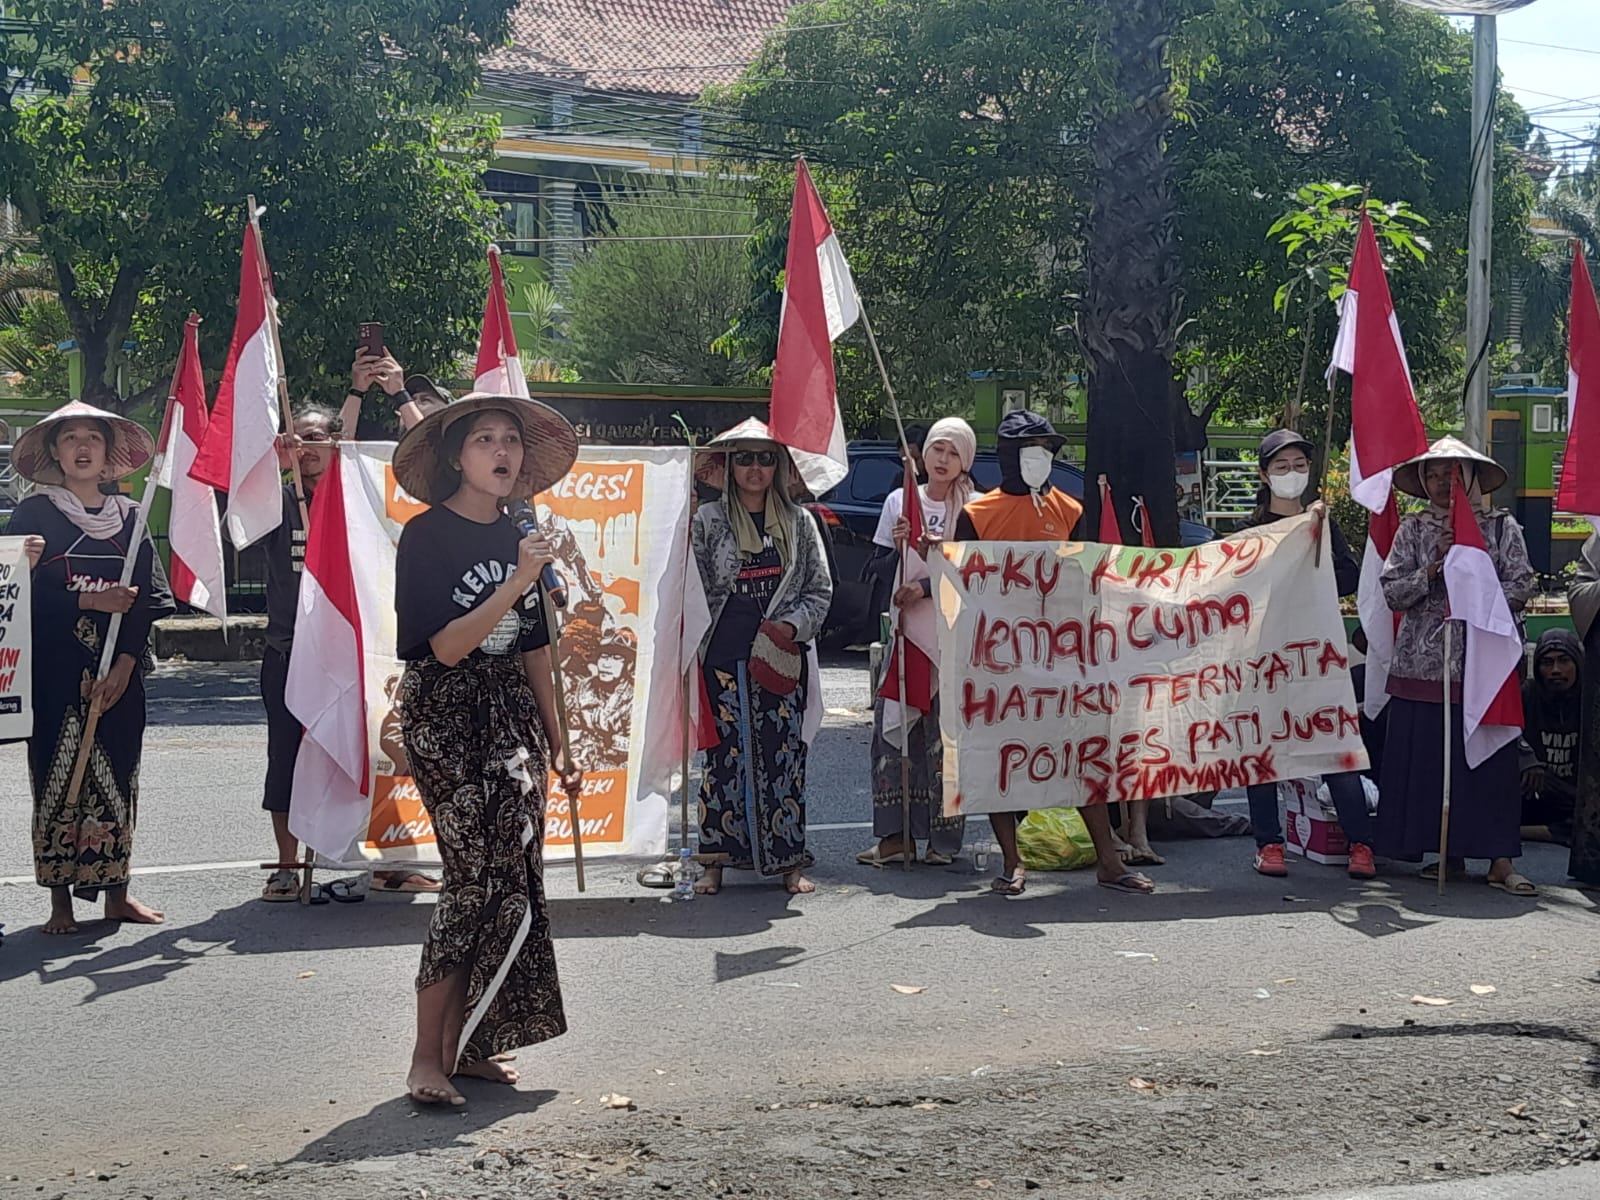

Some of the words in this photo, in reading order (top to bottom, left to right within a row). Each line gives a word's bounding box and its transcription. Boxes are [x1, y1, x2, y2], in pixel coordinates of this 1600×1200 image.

[958, 547, 1061, 597] AKU
[961, 678, 1121, 728] HATIKU
[1128, 639, 1348, 712] TERNYATA
[1188, 706, 1262, 765] PATI
[1271, 705, 1360, 744] JUGA
[1541, 731, 1578, 748] WHAT
